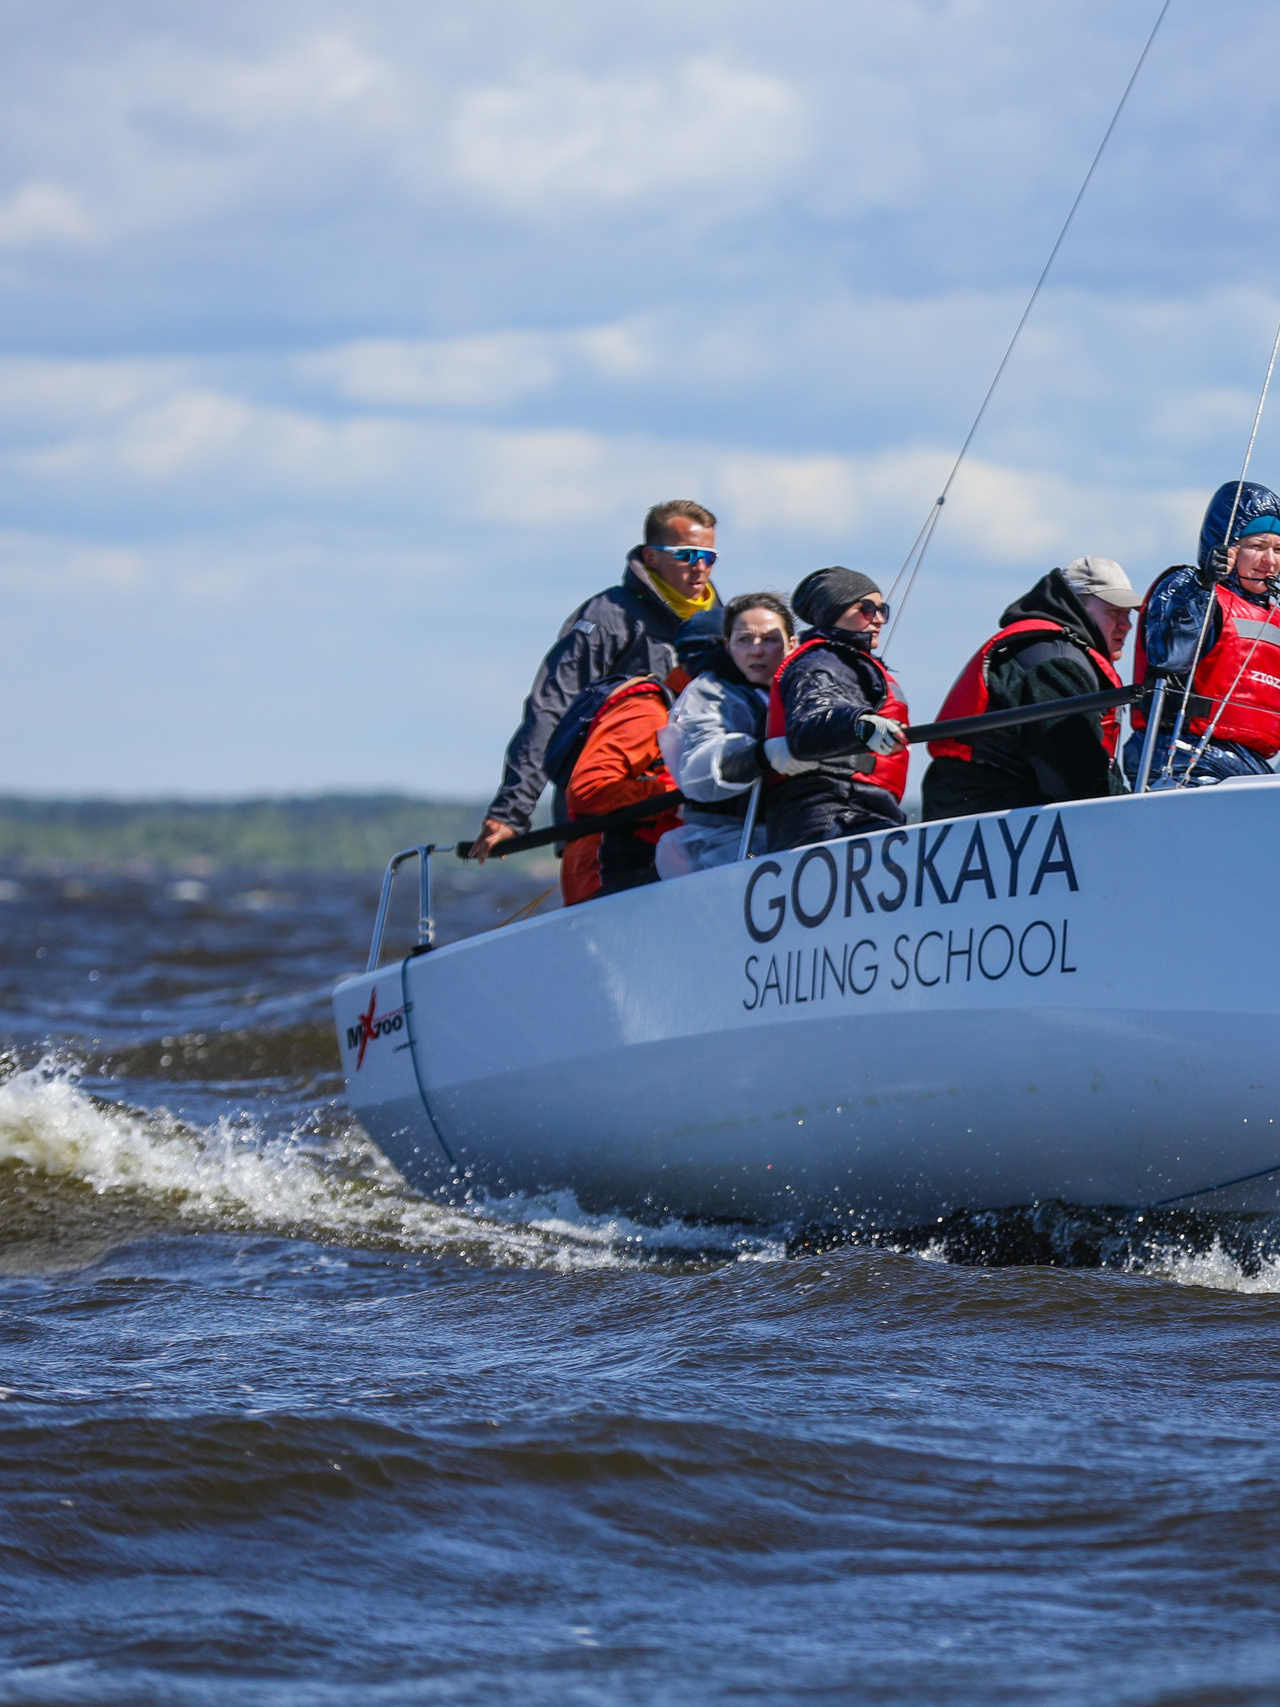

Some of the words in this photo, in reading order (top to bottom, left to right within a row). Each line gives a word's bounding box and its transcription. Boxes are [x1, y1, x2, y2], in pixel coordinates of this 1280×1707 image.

[744, 811, 1079, 943] GORSKAYA
[743, 939, 878, 1010] SAILING
[891, 919, 1076, 990] SCHOOL
